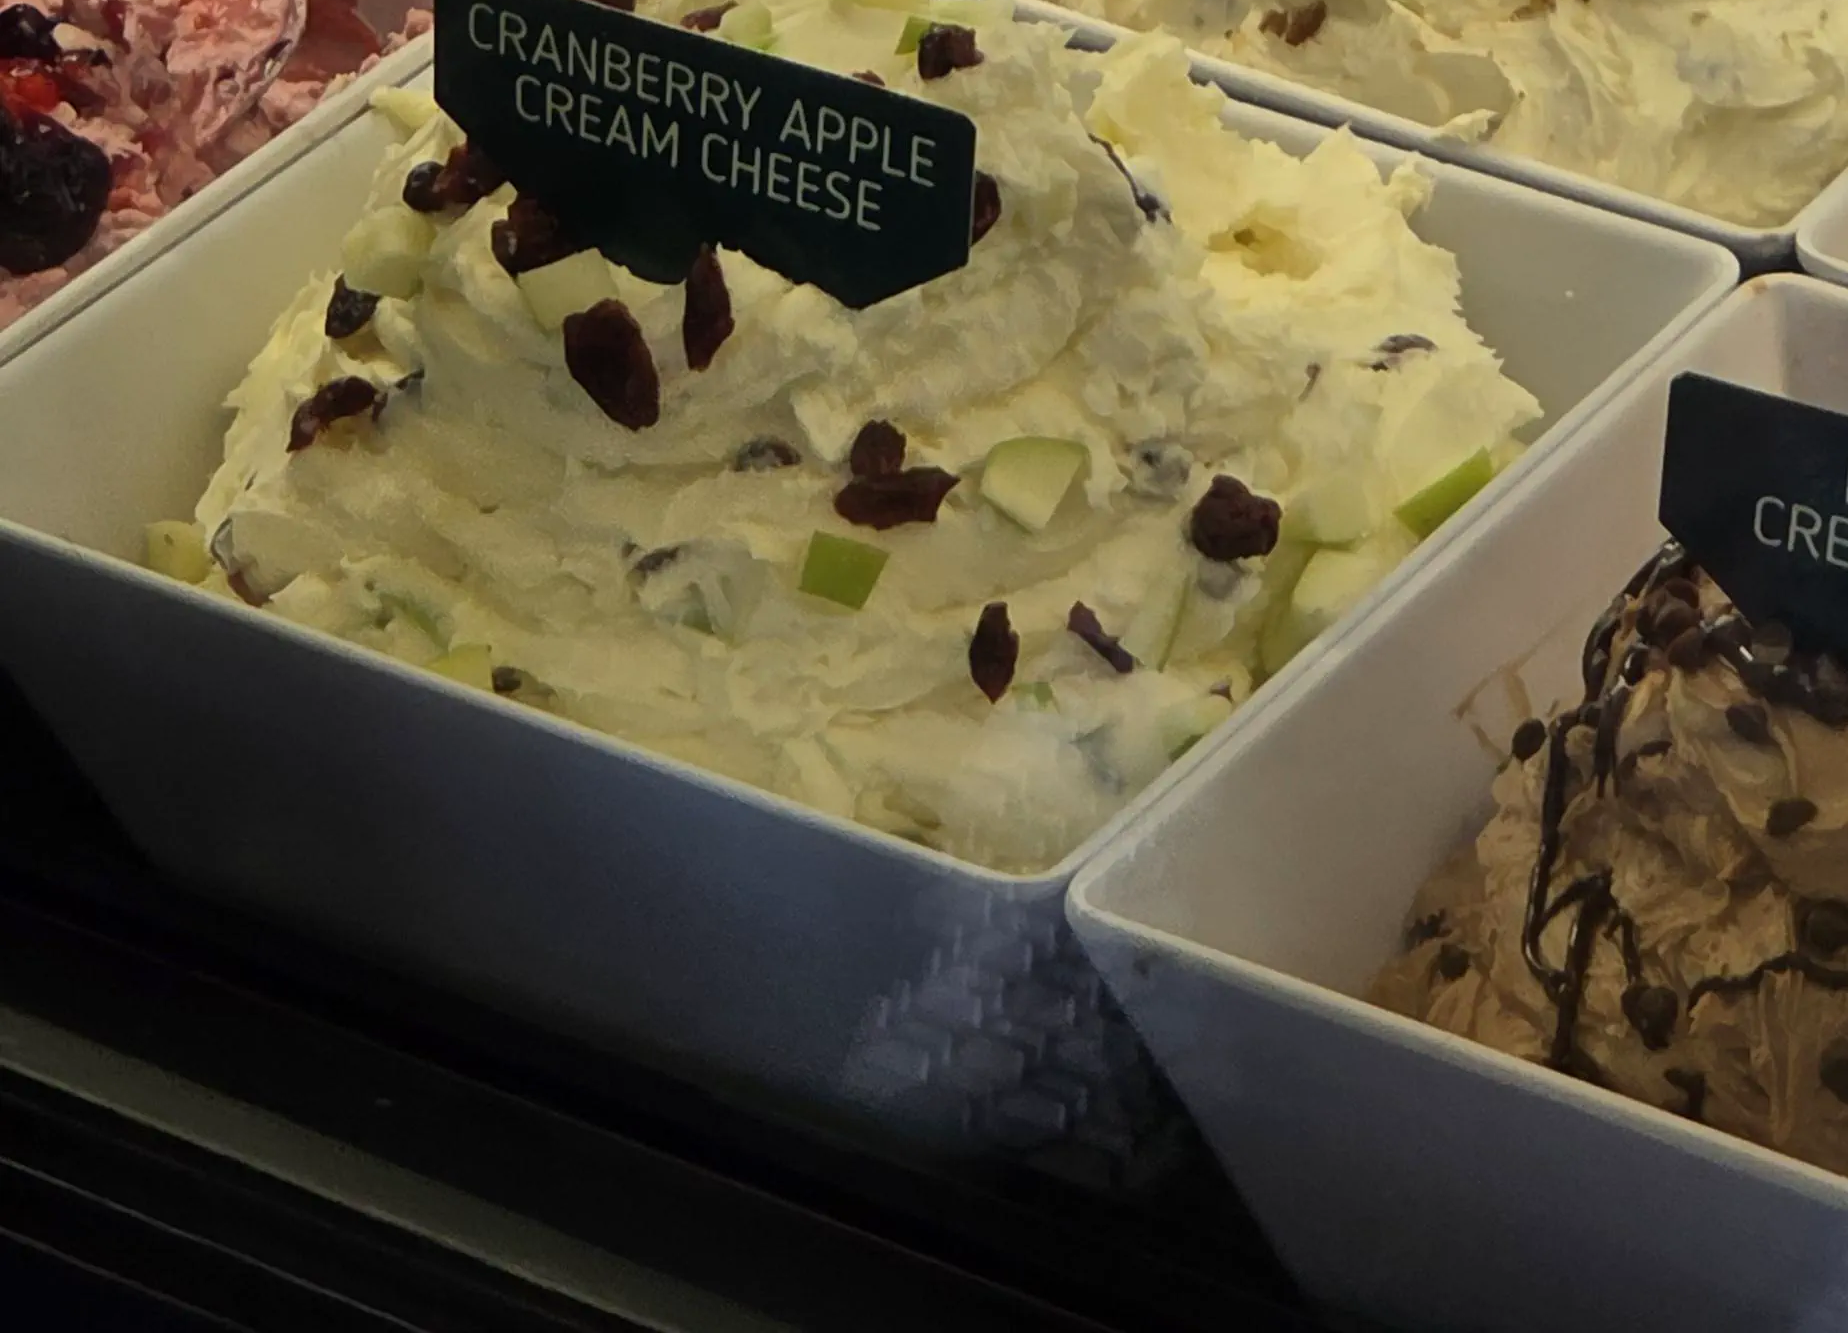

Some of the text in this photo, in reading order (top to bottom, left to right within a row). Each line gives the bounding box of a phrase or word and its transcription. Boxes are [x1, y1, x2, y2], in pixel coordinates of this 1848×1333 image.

[467, 2, 937, 188] CRANBERRY APPLE
[514, 75, 883, 232] CREAM CHEESE
